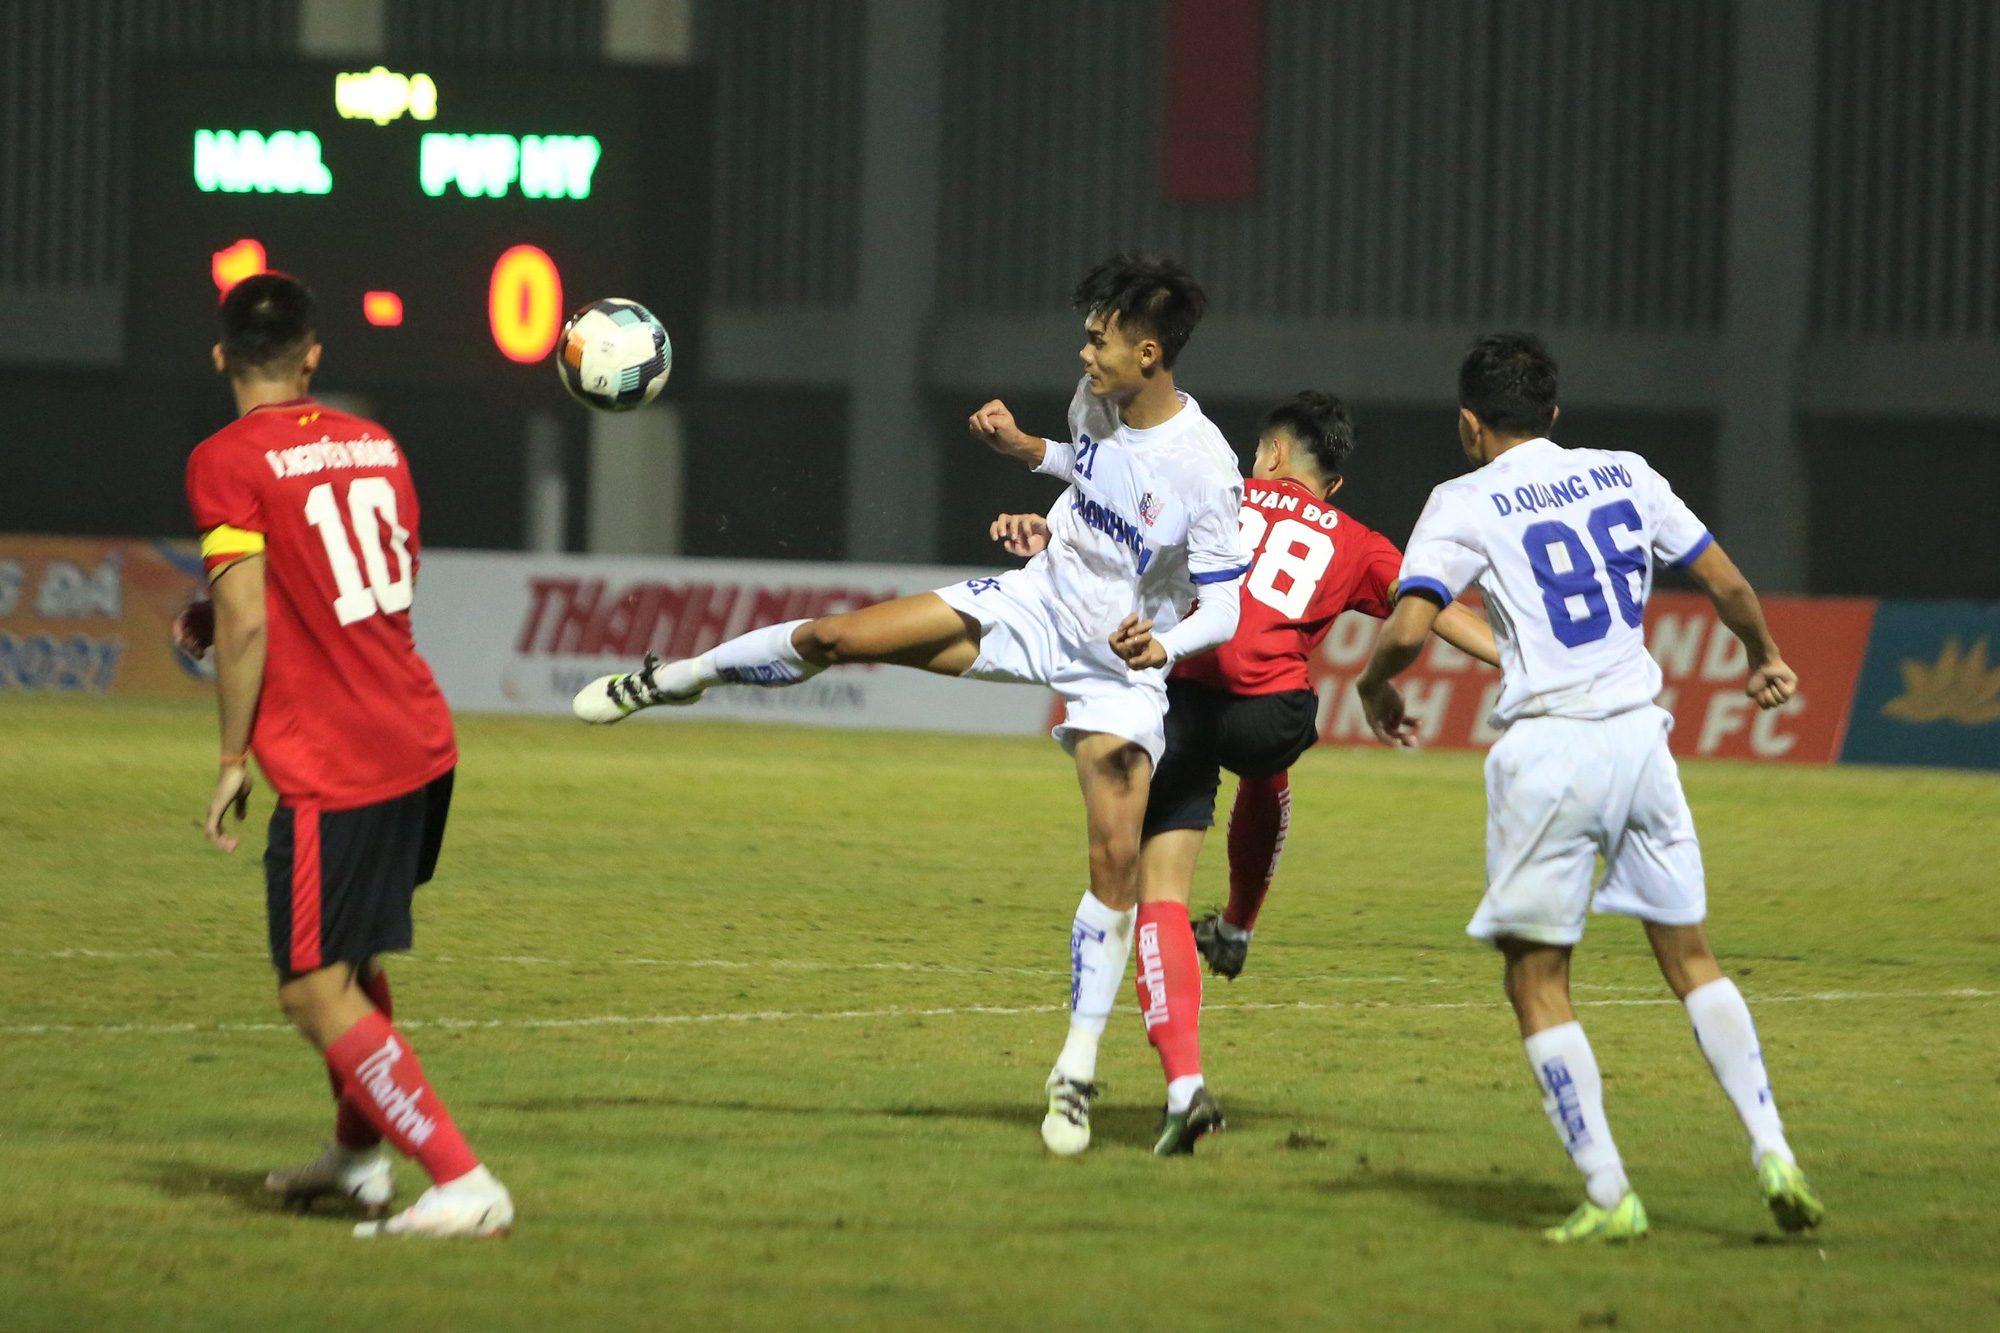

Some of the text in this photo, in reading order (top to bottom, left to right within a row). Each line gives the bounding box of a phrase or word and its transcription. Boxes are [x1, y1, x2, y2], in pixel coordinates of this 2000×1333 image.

[489, 244, 563, 363] 0
[1074, 433, 1099, 481] 21
[1490, 475, 1590, 517] D.QUANG
[304, 476, 414, 627] 10
[1301, 503, 1339, 530] ĐÔ
[1521, 498, 1647, 649] 86
